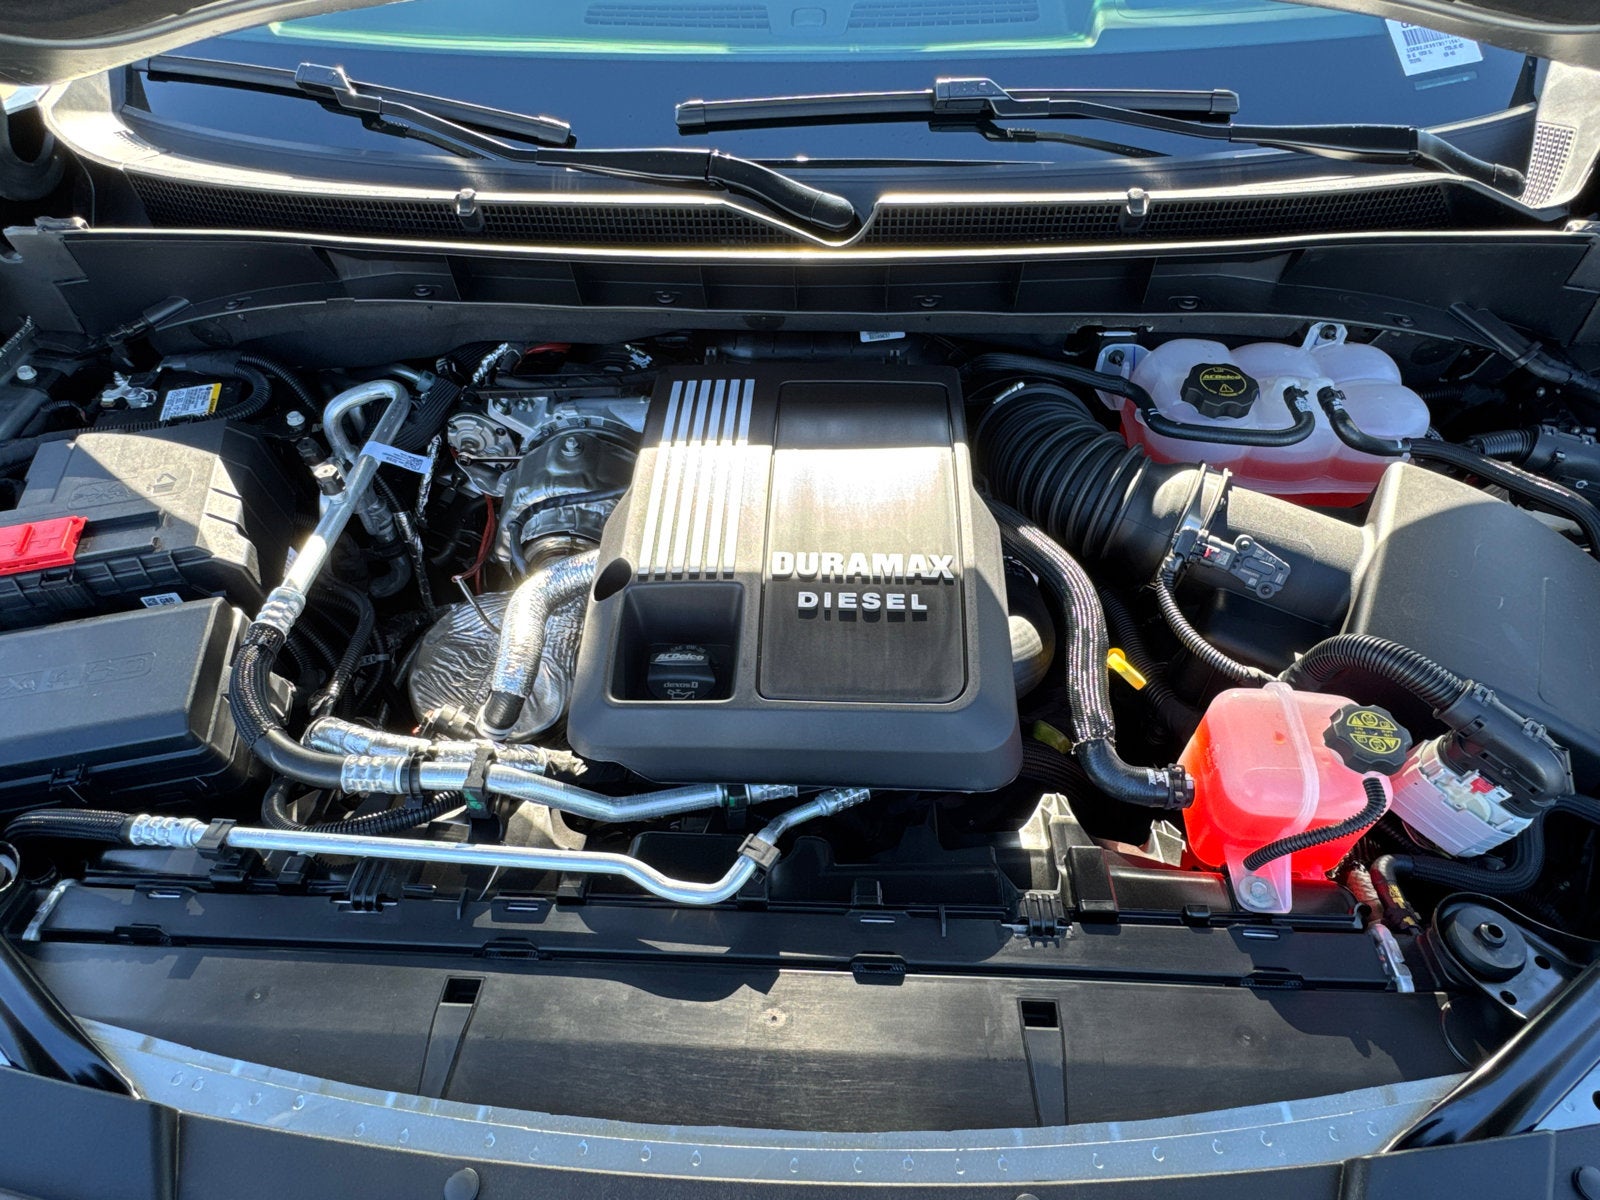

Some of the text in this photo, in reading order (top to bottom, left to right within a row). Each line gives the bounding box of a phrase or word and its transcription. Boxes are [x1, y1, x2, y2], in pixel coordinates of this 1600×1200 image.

[771, 551, 955, 582] DURAMAX
[797, 591, 928, 612] DIESEL
[654, 653, 705, 662] ACDelco
